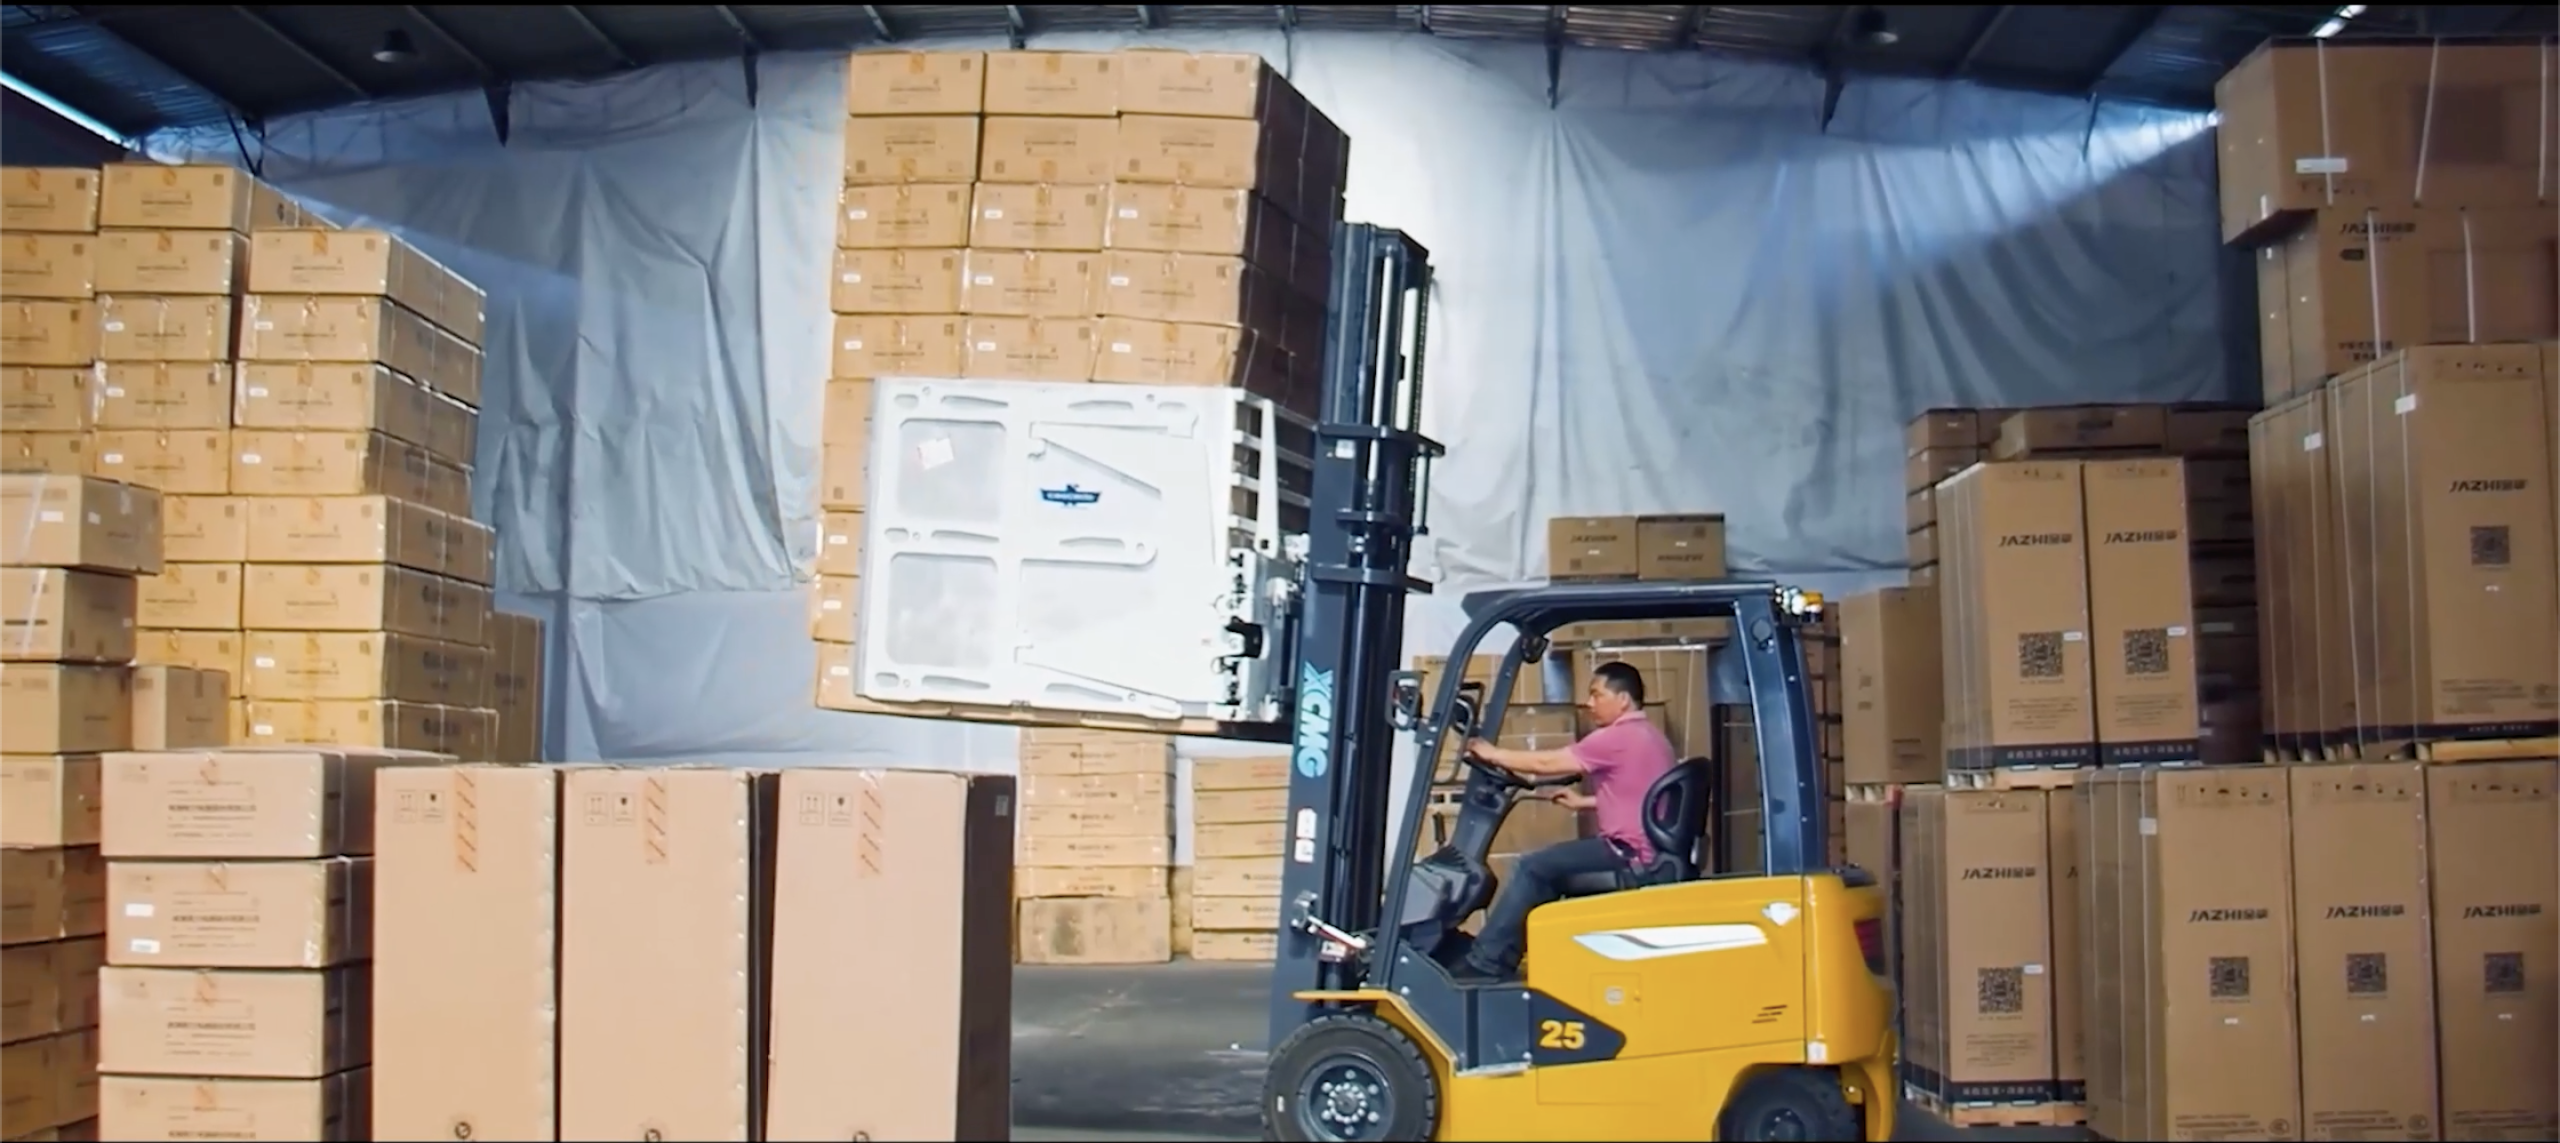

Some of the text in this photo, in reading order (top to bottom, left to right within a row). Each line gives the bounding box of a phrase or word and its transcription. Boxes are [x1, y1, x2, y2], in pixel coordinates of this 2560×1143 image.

[2448, 480, 2501, 494] JAZHI
[1998, 534, 2049, 547] JAZHI
[2103, 530, 2153, 545] JAZHI
[1296, 660, 1334, 779] XCMG
[1961, 867, 2012, 881] JAZHI
[2188, 908, 2242, 923] JAZHI
[2325, 905, 2379, 920] JAZHI
[2462, 904, 2516, 920] JAZHI
[1540, 1019, 1585, 1050] 25
